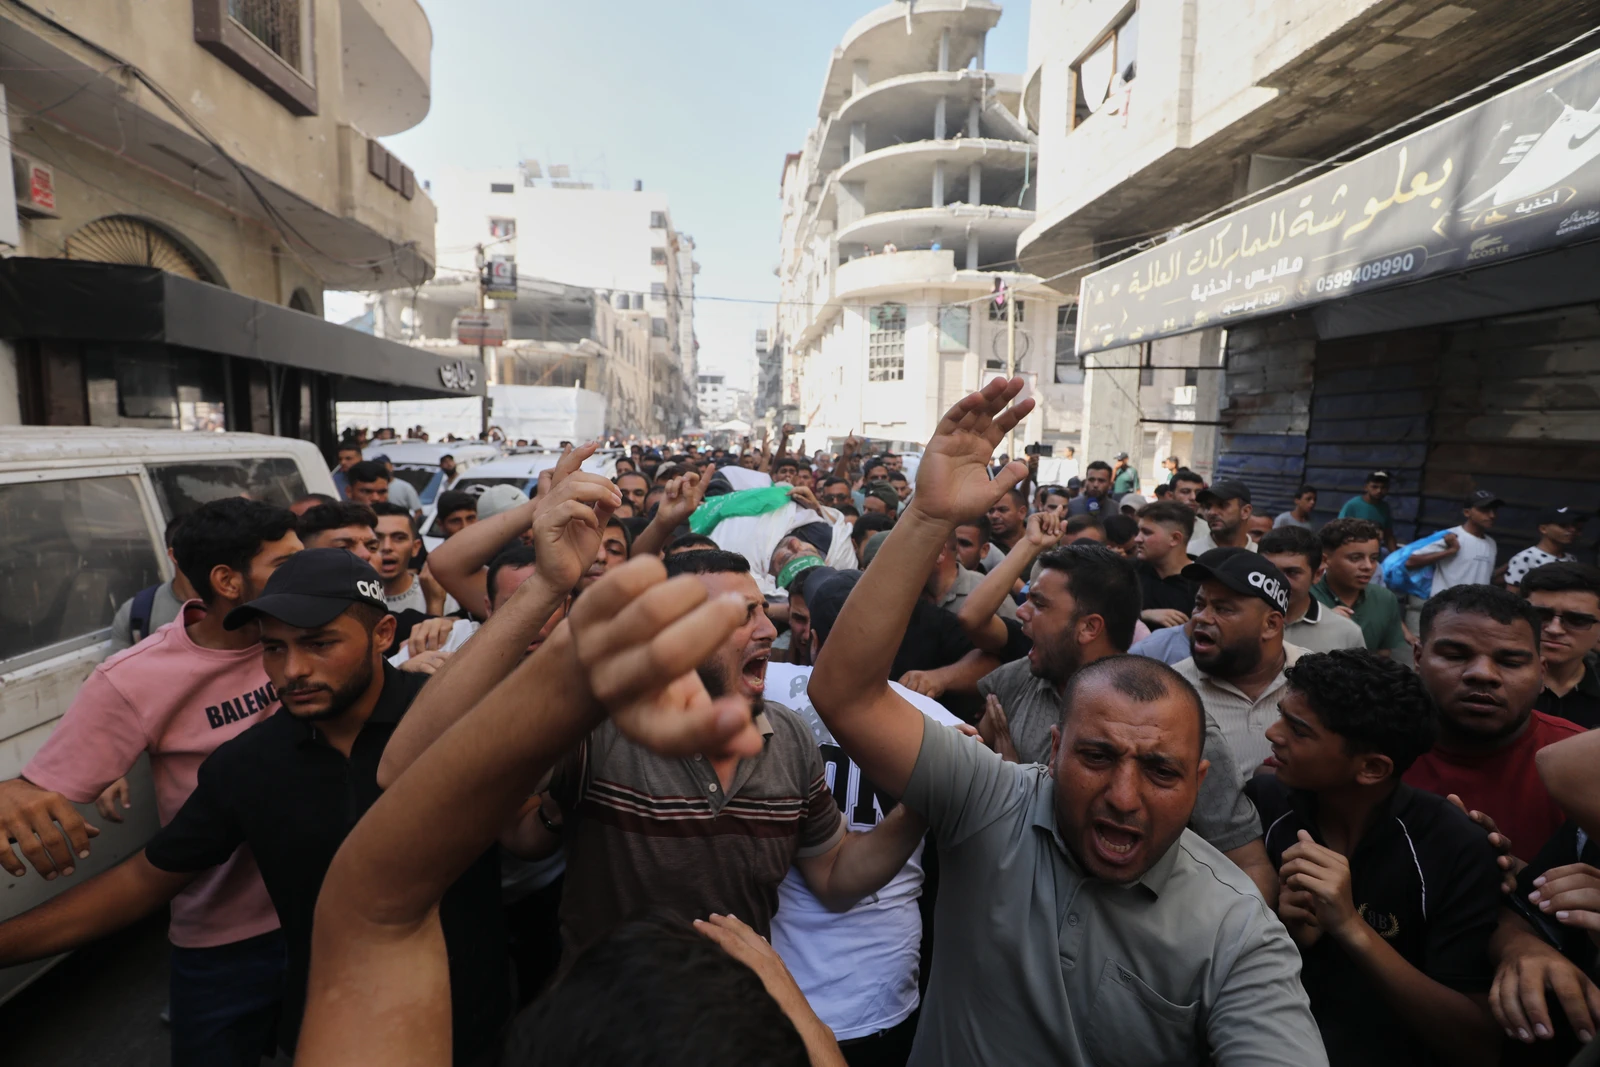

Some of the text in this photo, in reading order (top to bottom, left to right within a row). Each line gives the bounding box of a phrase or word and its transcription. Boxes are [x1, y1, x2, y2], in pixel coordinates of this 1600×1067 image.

[1289, 146, 1453, 241] بعلوشة
[1187, 208, 1285, 276] للماركات
[1244, 256, 1304, 290] ملابس
[1316, 252, 1414, 293] 0599409990
